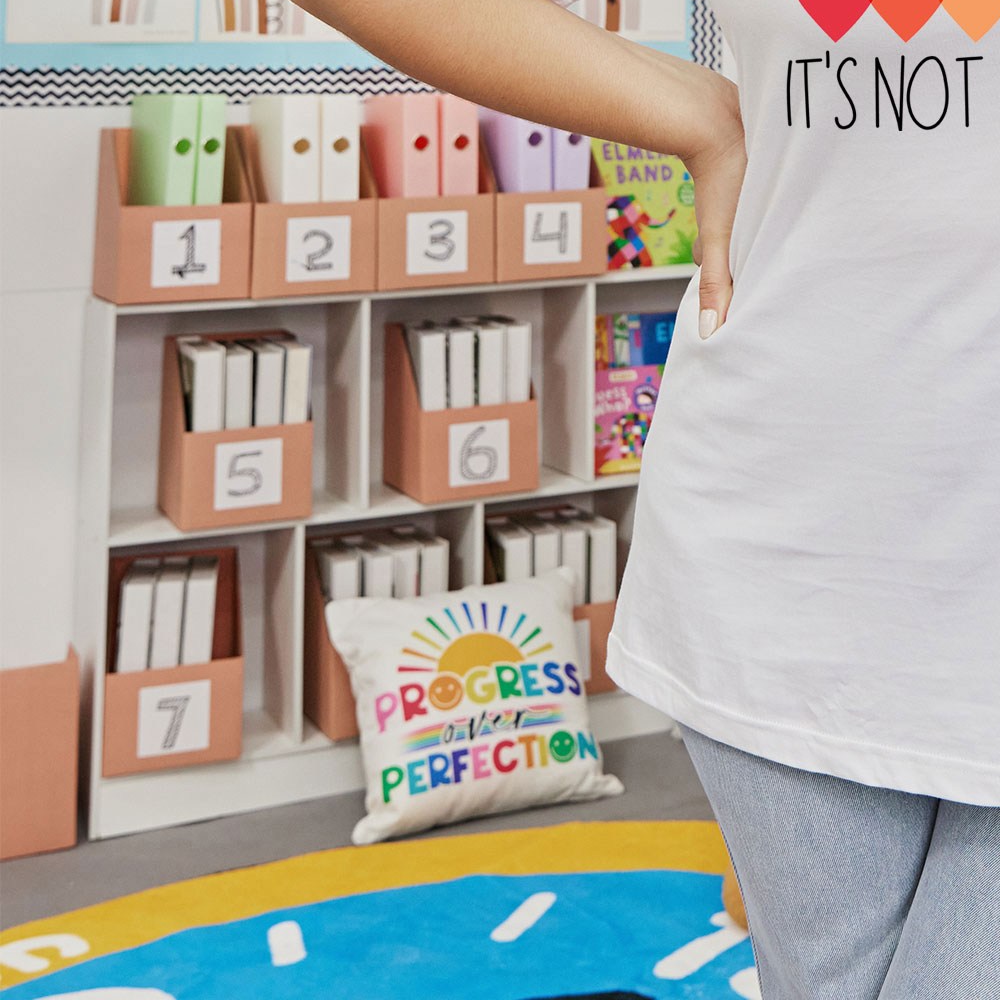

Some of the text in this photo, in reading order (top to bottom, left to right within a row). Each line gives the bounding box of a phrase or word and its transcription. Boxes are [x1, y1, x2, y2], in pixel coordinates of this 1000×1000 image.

[786, 50, 857, 131] IT'S
[874, 54, 984, 132] NOT
[616, 165, 673, 184] BAND
[171, 224, 206, 278] 1
[300, 229, 334, 273] 2
[424, 219, 456, 261] 3
[530, 210, 569, 255] 4
[226, 451, 262, 497] 5
[458, 425, 498, 481] 6
[155, 695, 192, 749] 7
[375, 661, 582, 734] PROGRESS
[443, 708, 531, 744] over
[381, 730, 599, 804] PERFECTION
